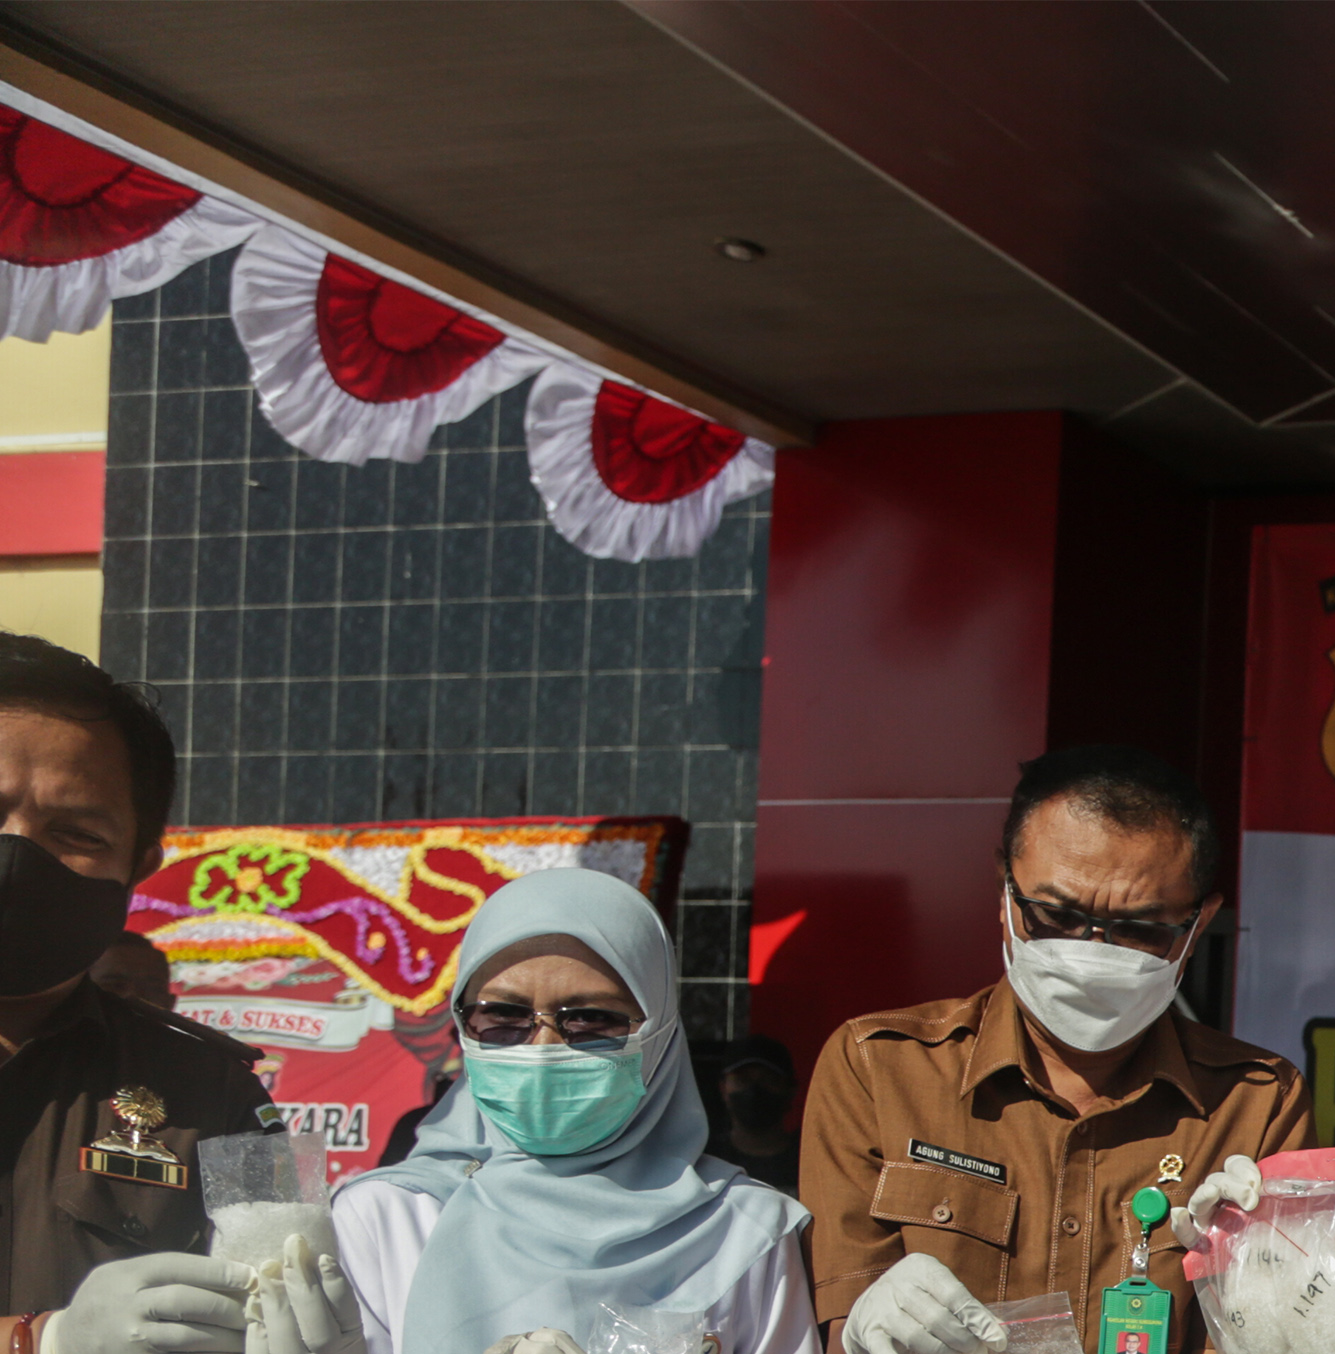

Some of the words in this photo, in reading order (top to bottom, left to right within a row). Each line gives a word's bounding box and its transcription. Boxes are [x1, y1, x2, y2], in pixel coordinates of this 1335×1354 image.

[240, 1010, 326, 1037] SUKSES
[915, 1145, 944, 1160] AGUNG
[948, 1154, 1000, 1177] SULISTIYONO
